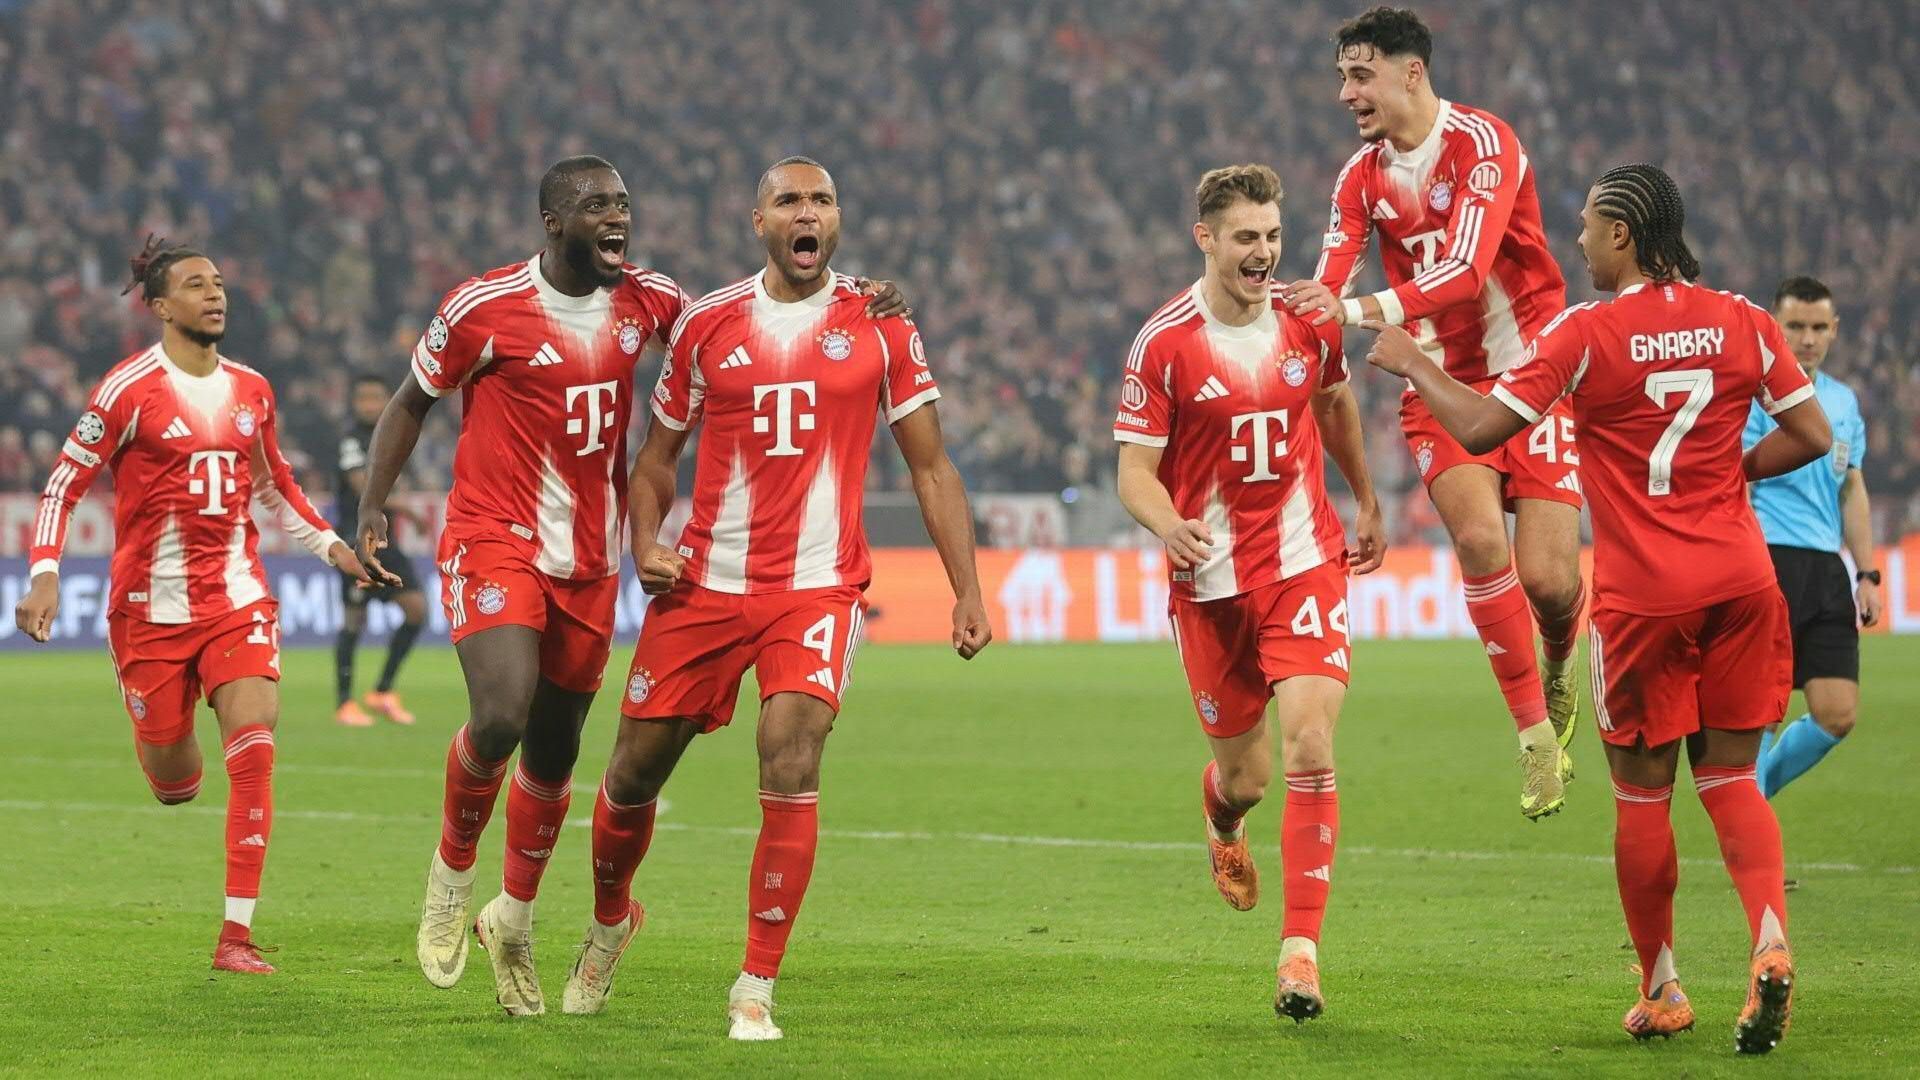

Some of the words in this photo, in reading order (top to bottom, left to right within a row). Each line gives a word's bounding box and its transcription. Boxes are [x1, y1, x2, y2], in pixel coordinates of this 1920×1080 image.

[1630, 327, 1724, 362] GNABRY
[566, 380, 618, 457] T
[753, 381, 815, 456] T
[1116, 411, 1149, 428] Allianz
[1528, 415, 1580, 466] 45
[1644, 368, 1714, 496] 7
[1231, 408, 1288, 483] T
[189, 451, 237, 515] T
[247, 611, 280, 650] 1
[802, 613, 835, 662] 4
[1291, 595, 1350, 647] 44
